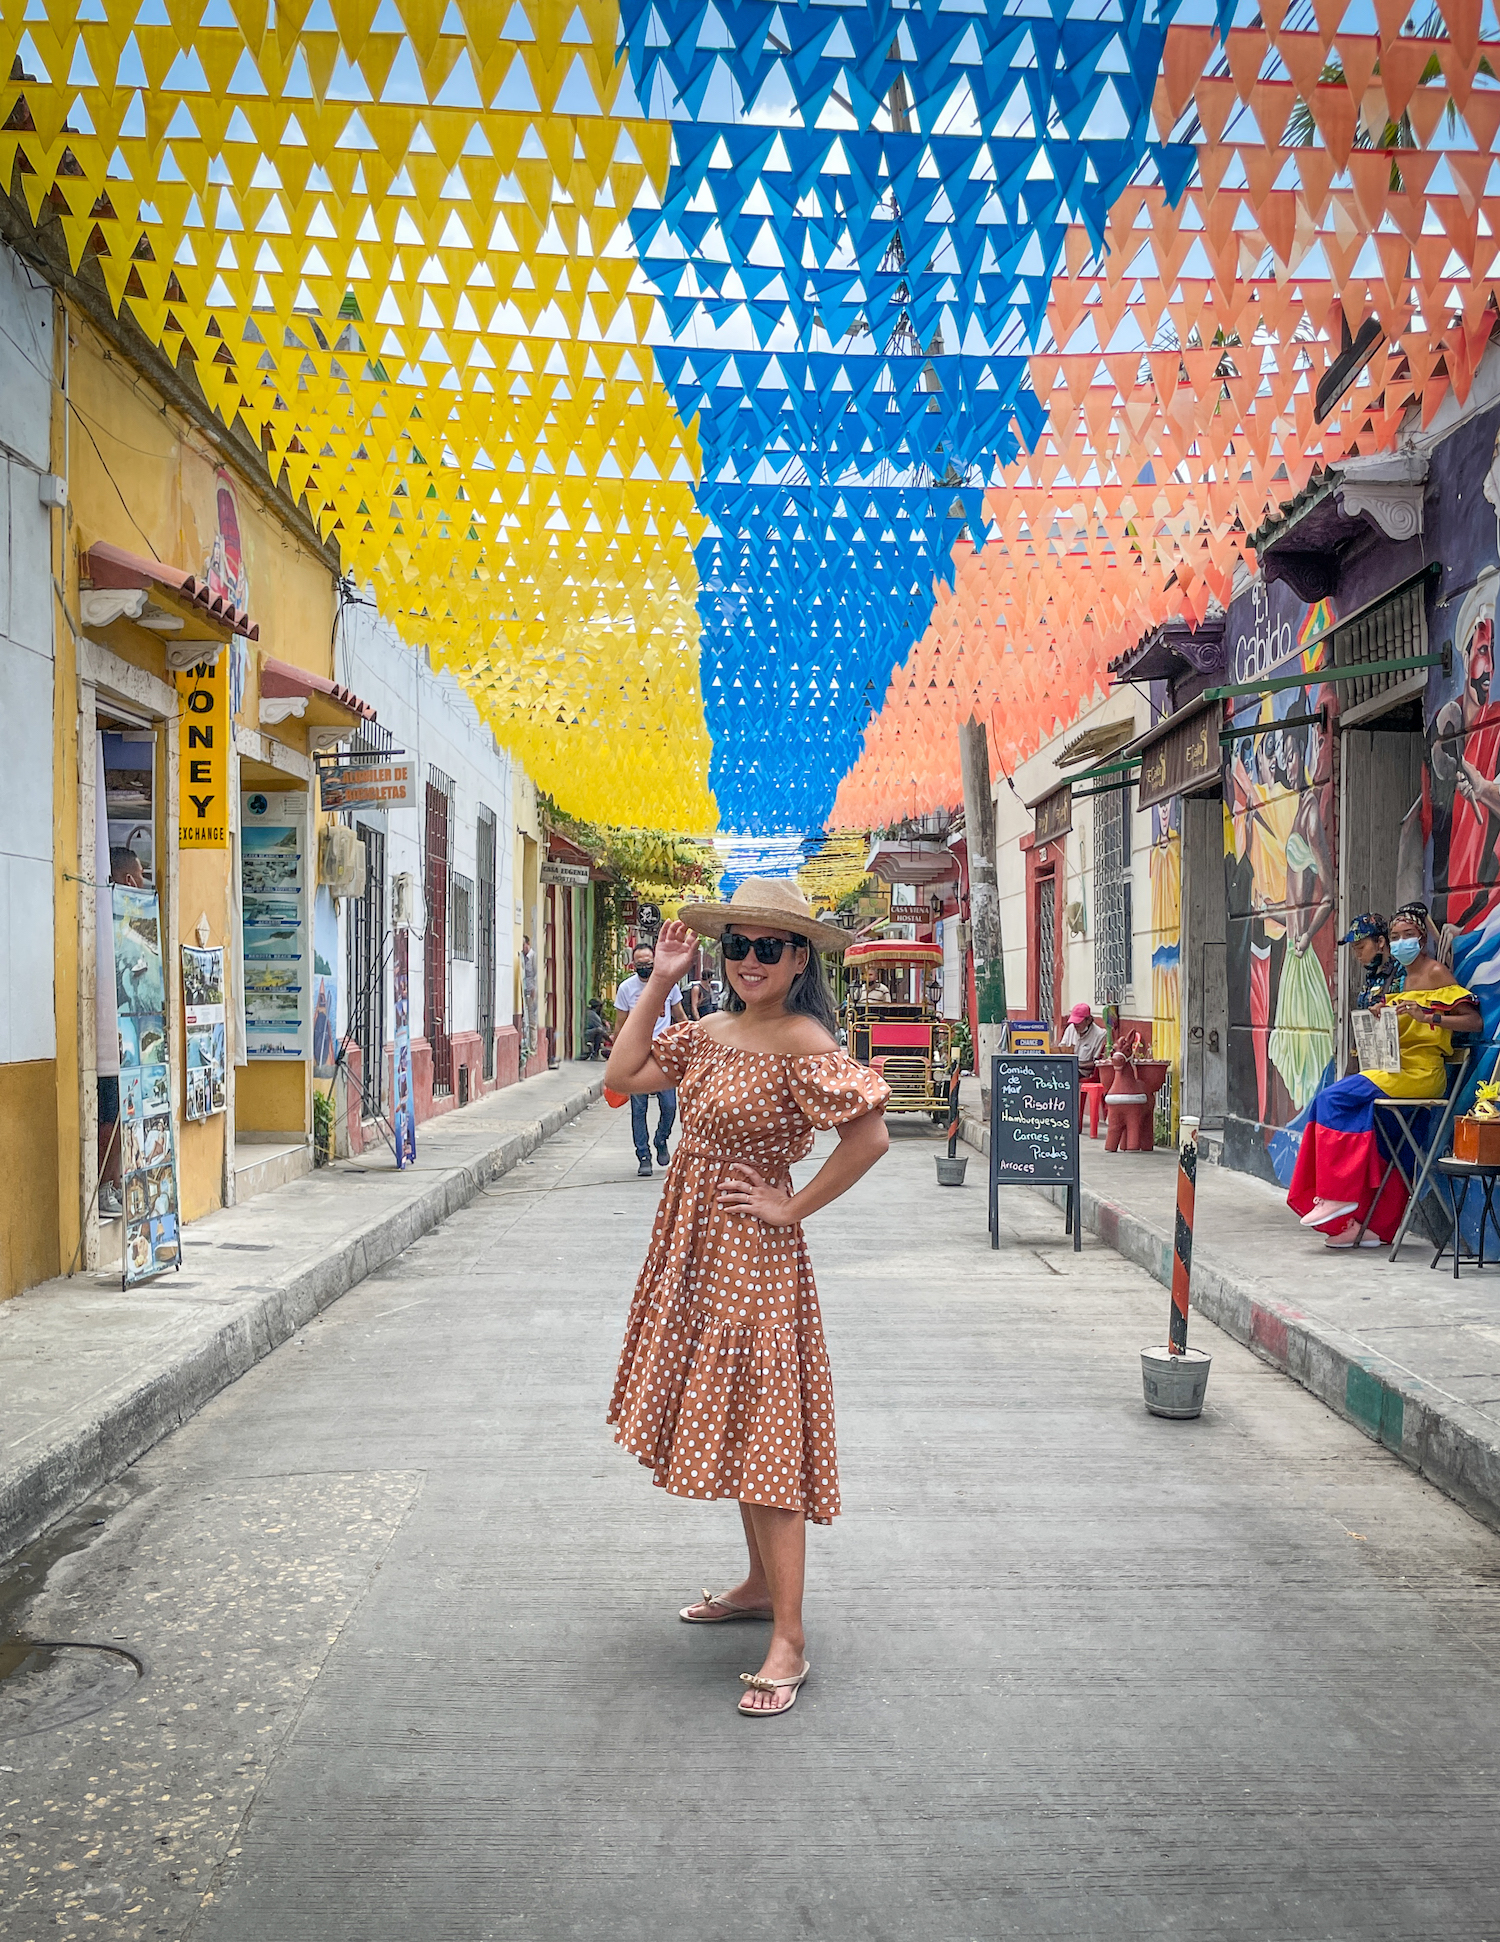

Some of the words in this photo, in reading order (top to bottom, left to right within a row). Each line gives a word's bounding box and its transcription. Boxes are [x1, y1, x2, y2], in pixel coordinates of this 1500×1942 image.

[1235, 612, 1292, 685] Cabildo
[186, 661, 215, 818] MONEY
[342, 768, 392, 784] ALQUILER
[394, 767, 408, 781] DE
[344, 785, 407, 802] BICICLETAS
[179, 827, 224, 840] EXCHANGE
[552, 875, 576, 883] HOSTEL
[561, 868, 588, 876] EUGENIA
[999, 1062, 1036, 1076] Comida
[1007, 1076, 1021, 1085] de
[1032, 1076, 1071, 1091] Pastas
[1001, 1085, 1021, 1095] Mar
[1022, 1094, 1066, 1111] Risotto
[1001, 1109, 1071, 1130] Hamburguesas
[1013, 1128, 1050, 1142] Carnes
[1029, 1144, 1068, 1160] Picadas
[1000, 1160, 1035, 1173] Arroces
